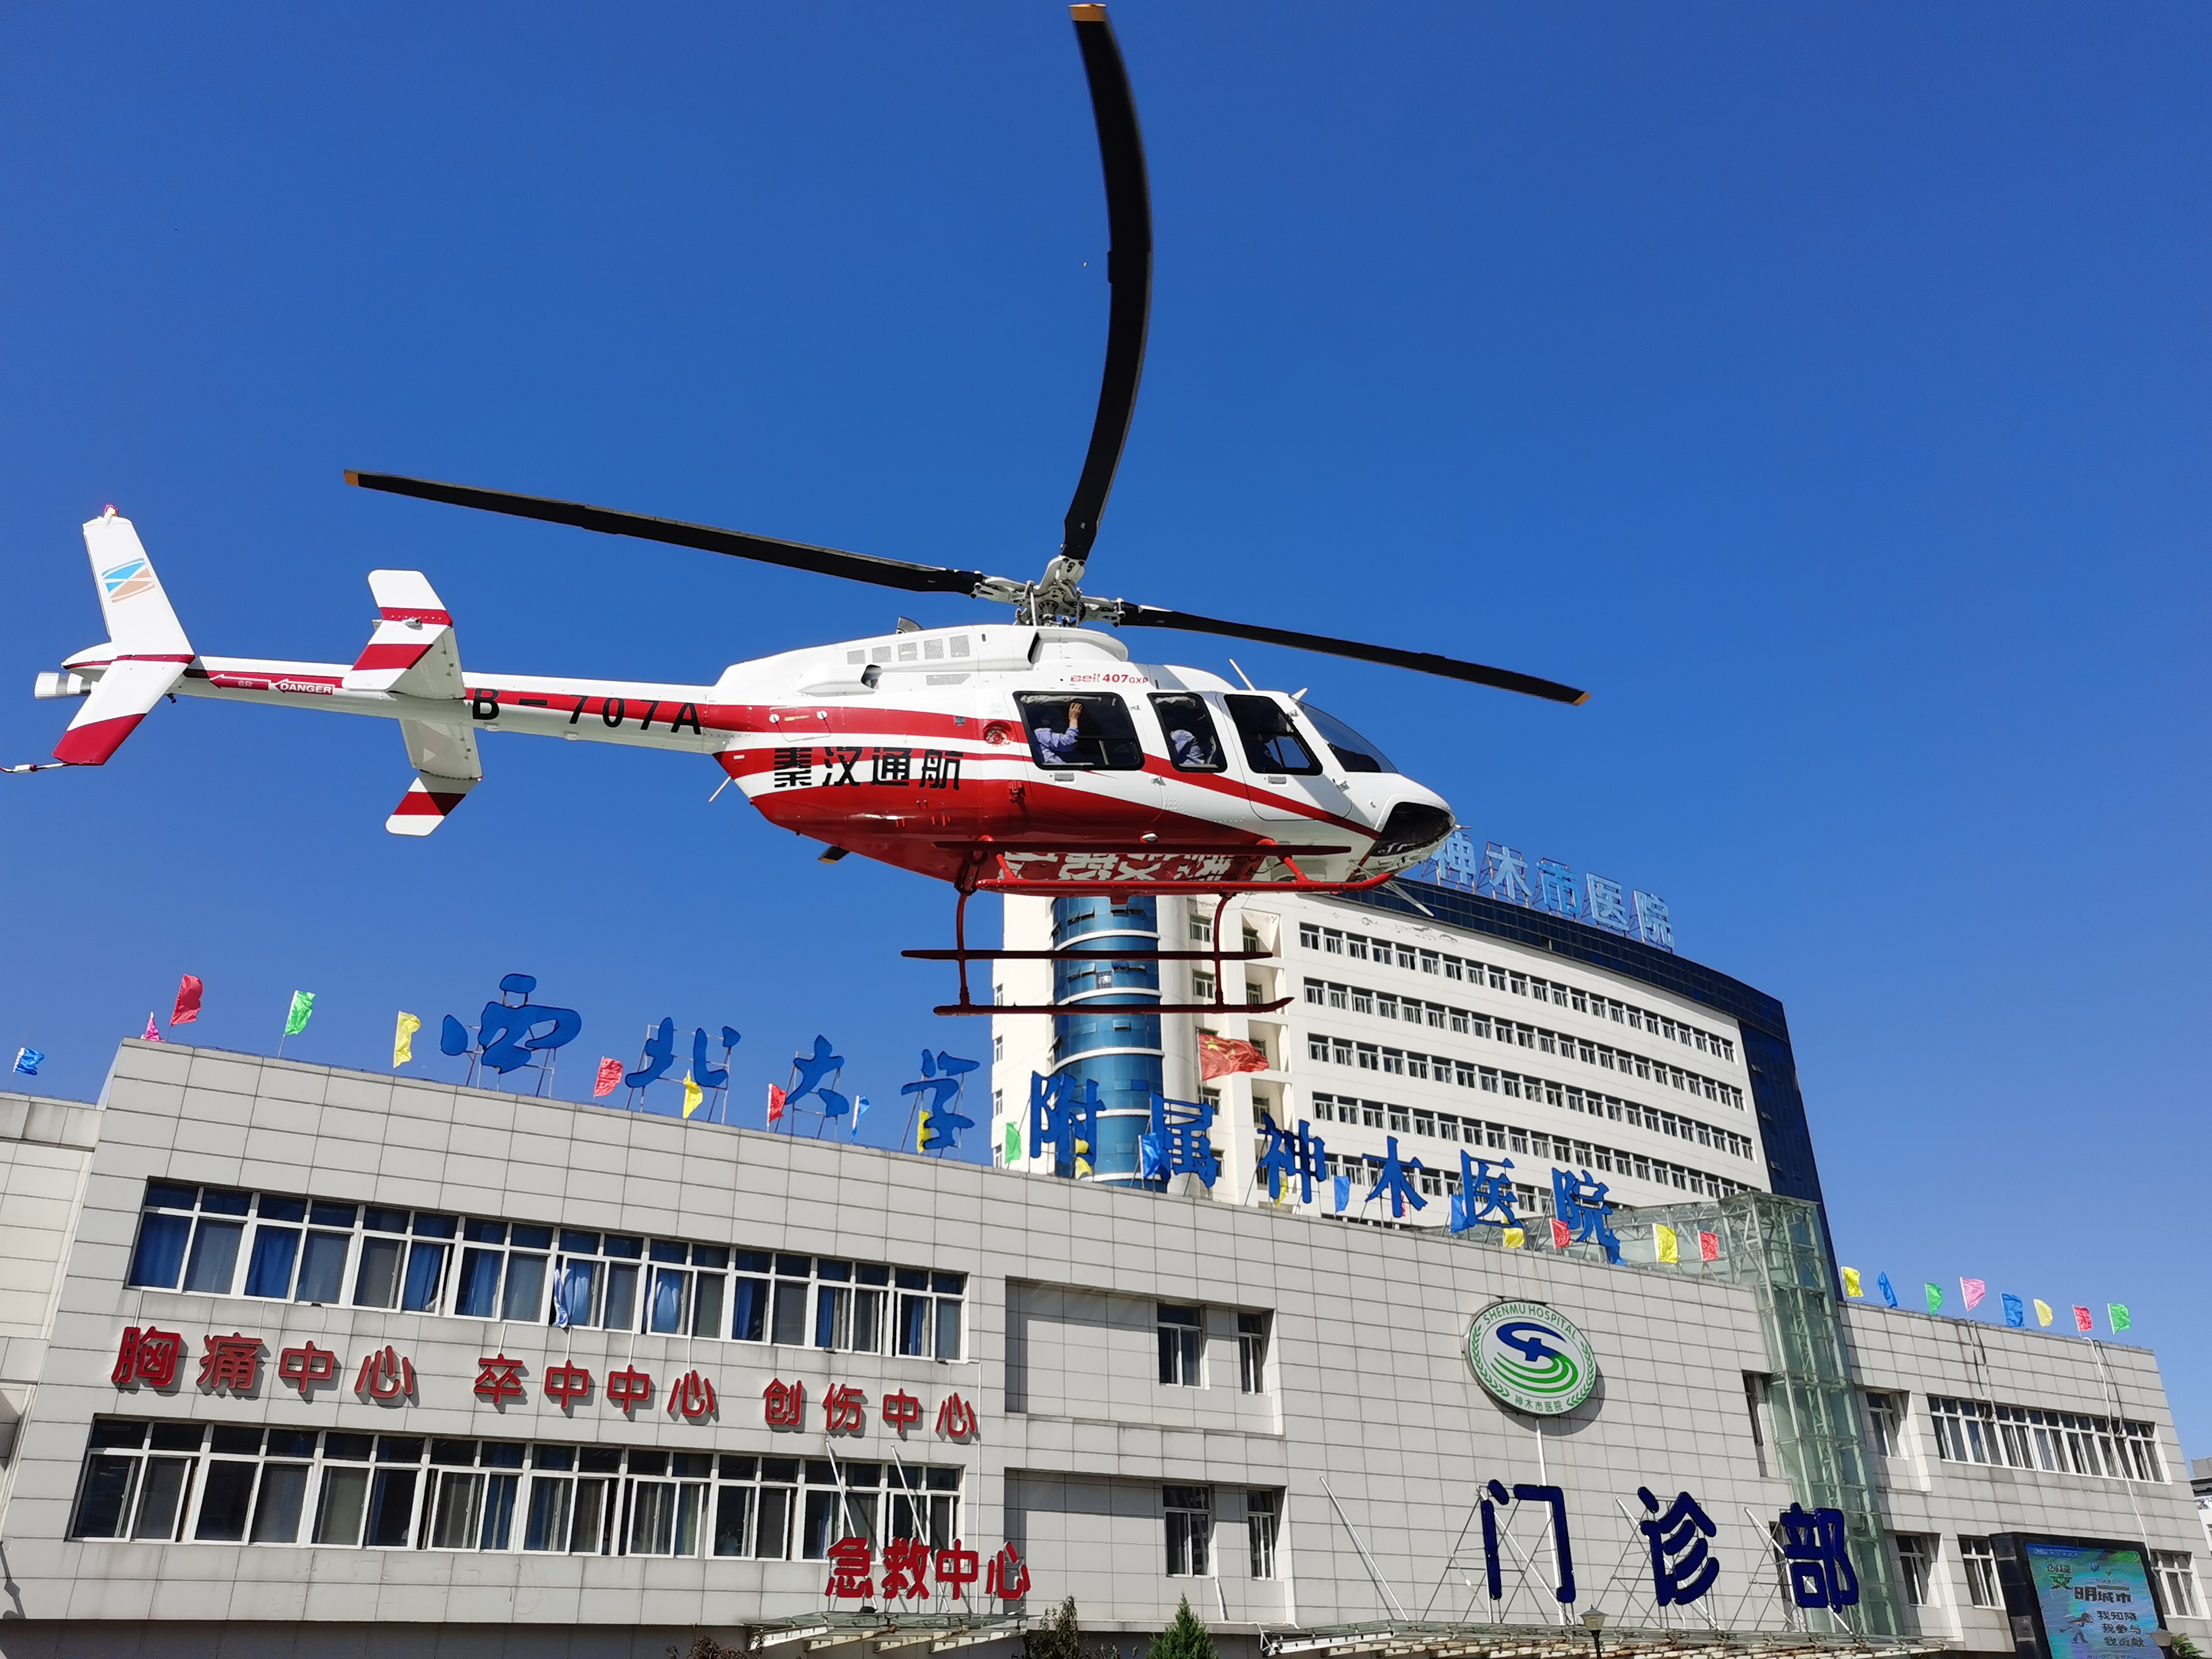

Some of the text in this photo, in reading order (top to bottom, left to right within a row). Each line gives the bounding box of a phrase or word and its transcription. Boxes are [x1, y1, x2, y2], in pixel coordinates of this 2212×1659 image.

[280, 683, 332, 694] DANGER
[1071, 673, 1100, 682] Bell
[774, 746, 964, 790] 秦汉通航
[1432, 831, 1674, 947] 神木市医院
[1483, 1304, 1577, 1340] SHENMU HOSPITAL
[112, 1326, 978, 1438] 胸痛中心 卒中中心 创伤中心
[1515, 1395, 1564, 1412] 神木市医院
[1480, 1479, 1859, 1613] 门诊部
[825, 1537, 1031, 1600] 急救中心
